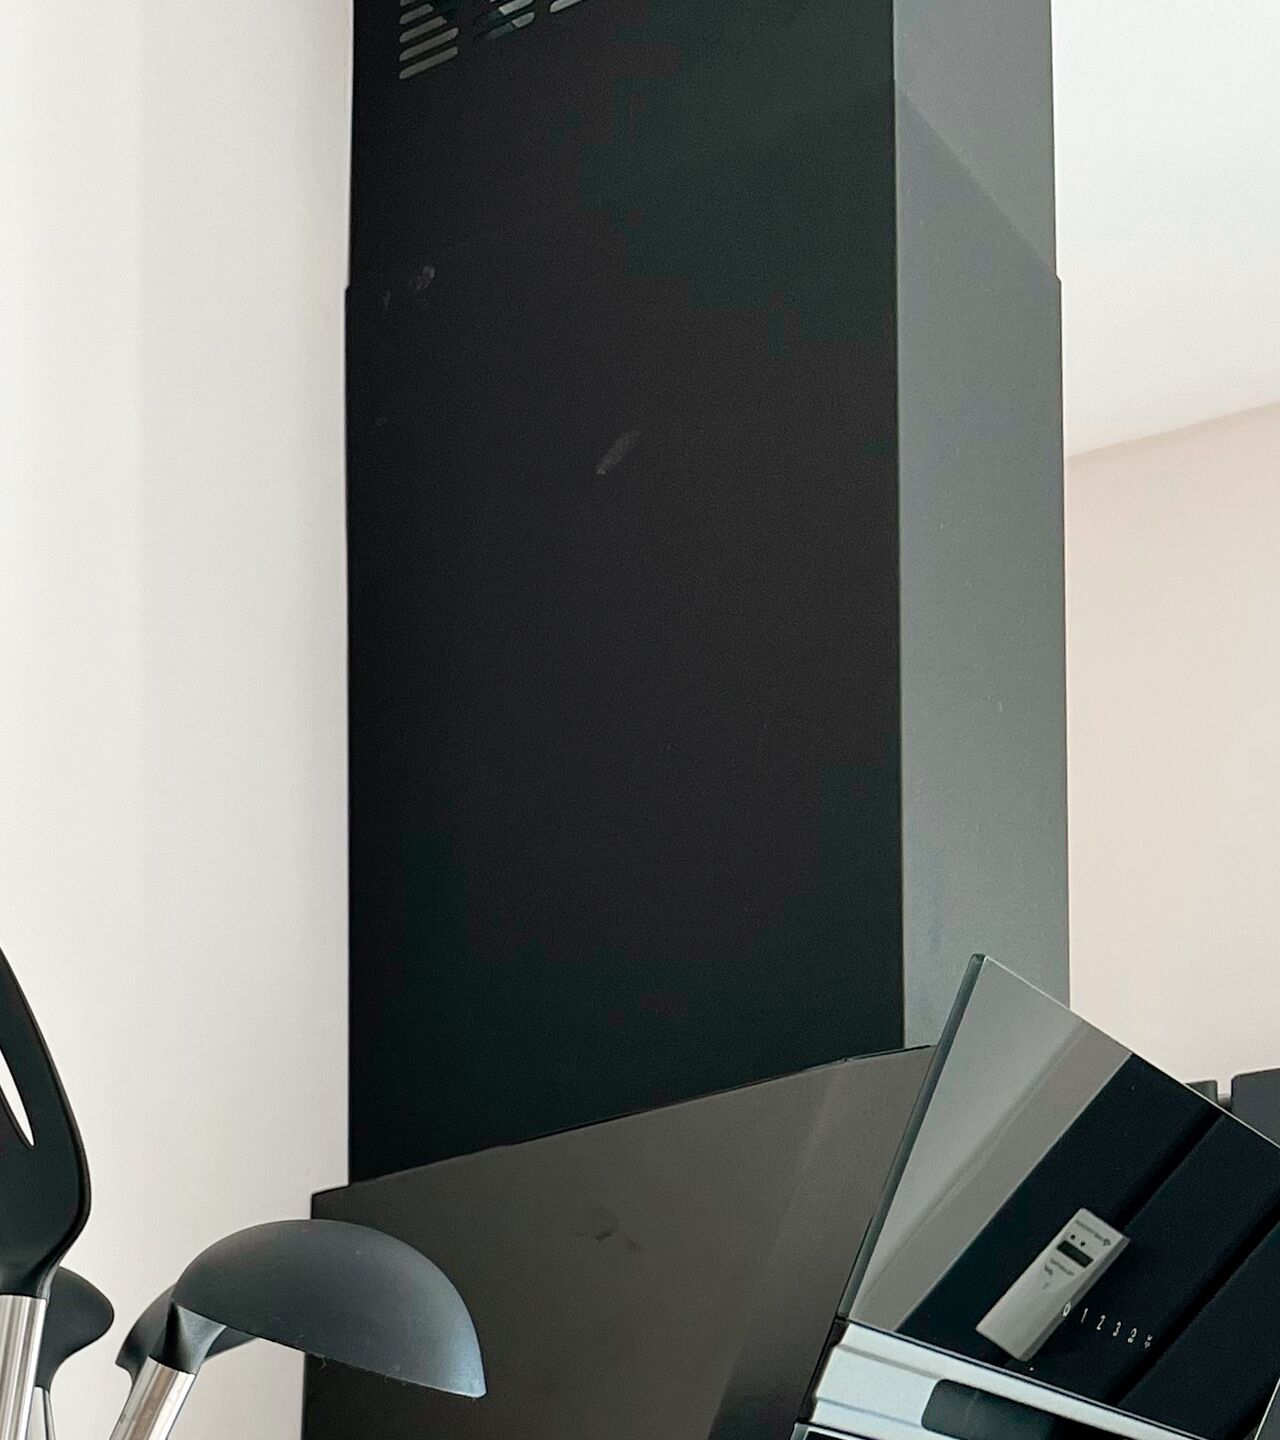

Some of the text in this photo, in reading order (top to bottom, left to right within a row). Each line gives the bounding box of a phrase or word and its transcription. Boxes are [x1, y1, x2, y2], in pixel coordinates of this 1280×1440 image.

[1081, 1308, 1088, 1323] 1
[1096, 1315, 1105, 1330] 2
[1112, 1321, 1121, 1337] 3
